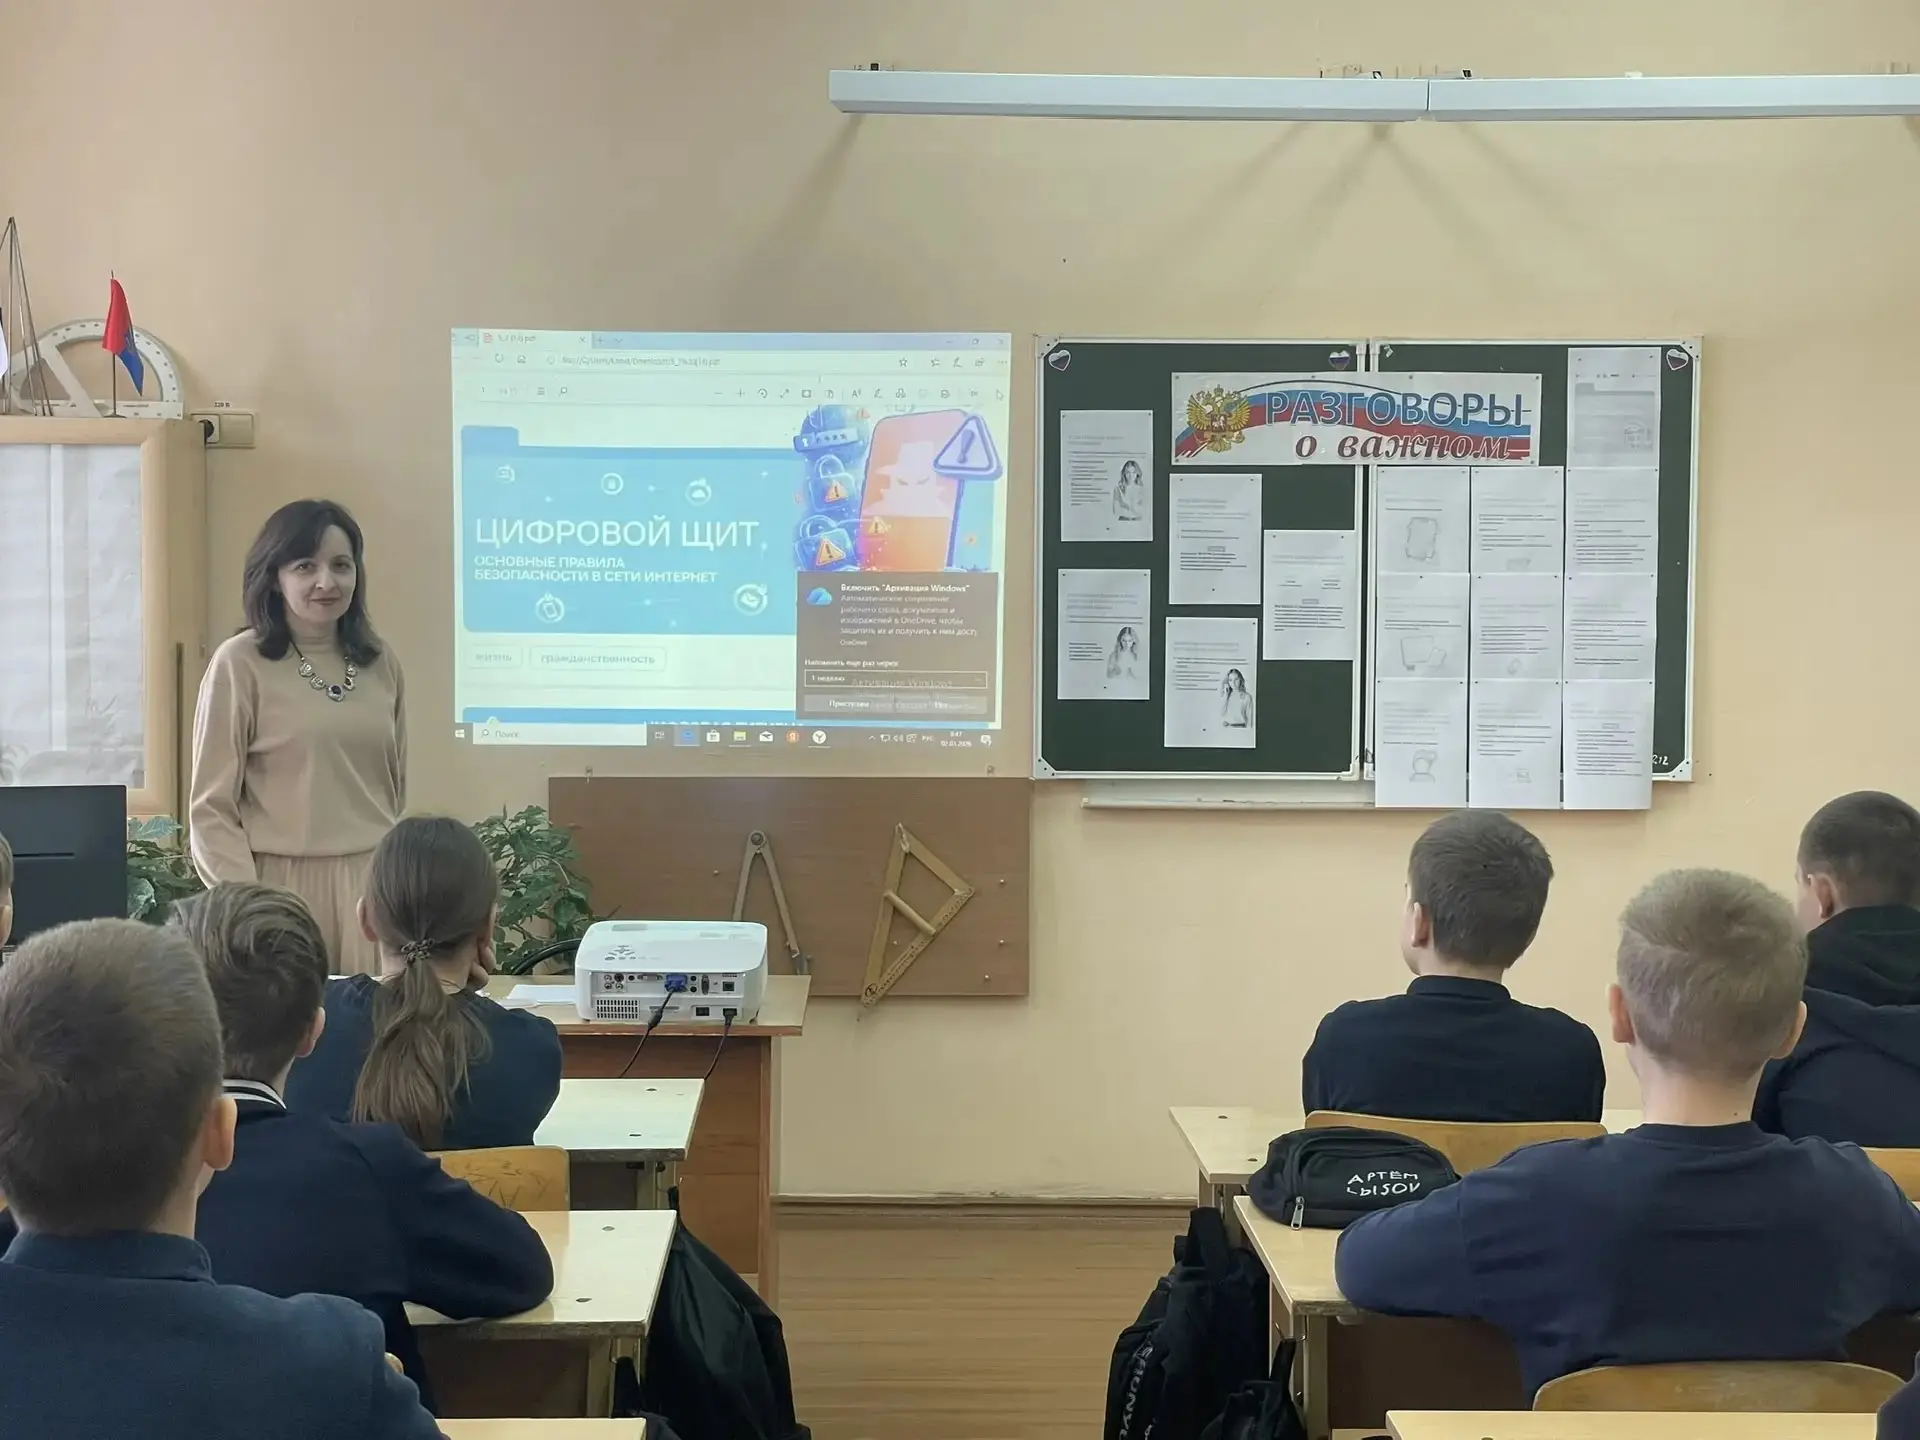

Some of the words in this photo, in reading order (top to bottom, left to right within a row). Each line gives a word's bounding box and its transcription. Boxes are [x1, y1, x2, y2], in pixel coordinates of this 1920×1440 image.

[1264, 391, 1523, 427] РАЗГОВОРЫ
[1295, 435, 1318, 459] о
[1337, 435, 1511, 461] важном
[475, 514, 671, 549] ЦИФРОВОЙ
[681, 520, 760, 551] ЩИТ
[474, 556, 556, 568] ОСНОВНЫЕ
[559, 557, 626, 569] ПРАВИЛА
[474, 569, 589, 582] БЕЗОПАСНОСТИ
[592, 571, 602, 582] В
[604, 571, 642, 583] СЕТИ
[644, 571, 718, 583] ИНТЕРНЕТ
[841, 583, 880, 592] Включить
[931, 584, 971, 593] Windows"
[540, 654, 656, 666] гражданственность
